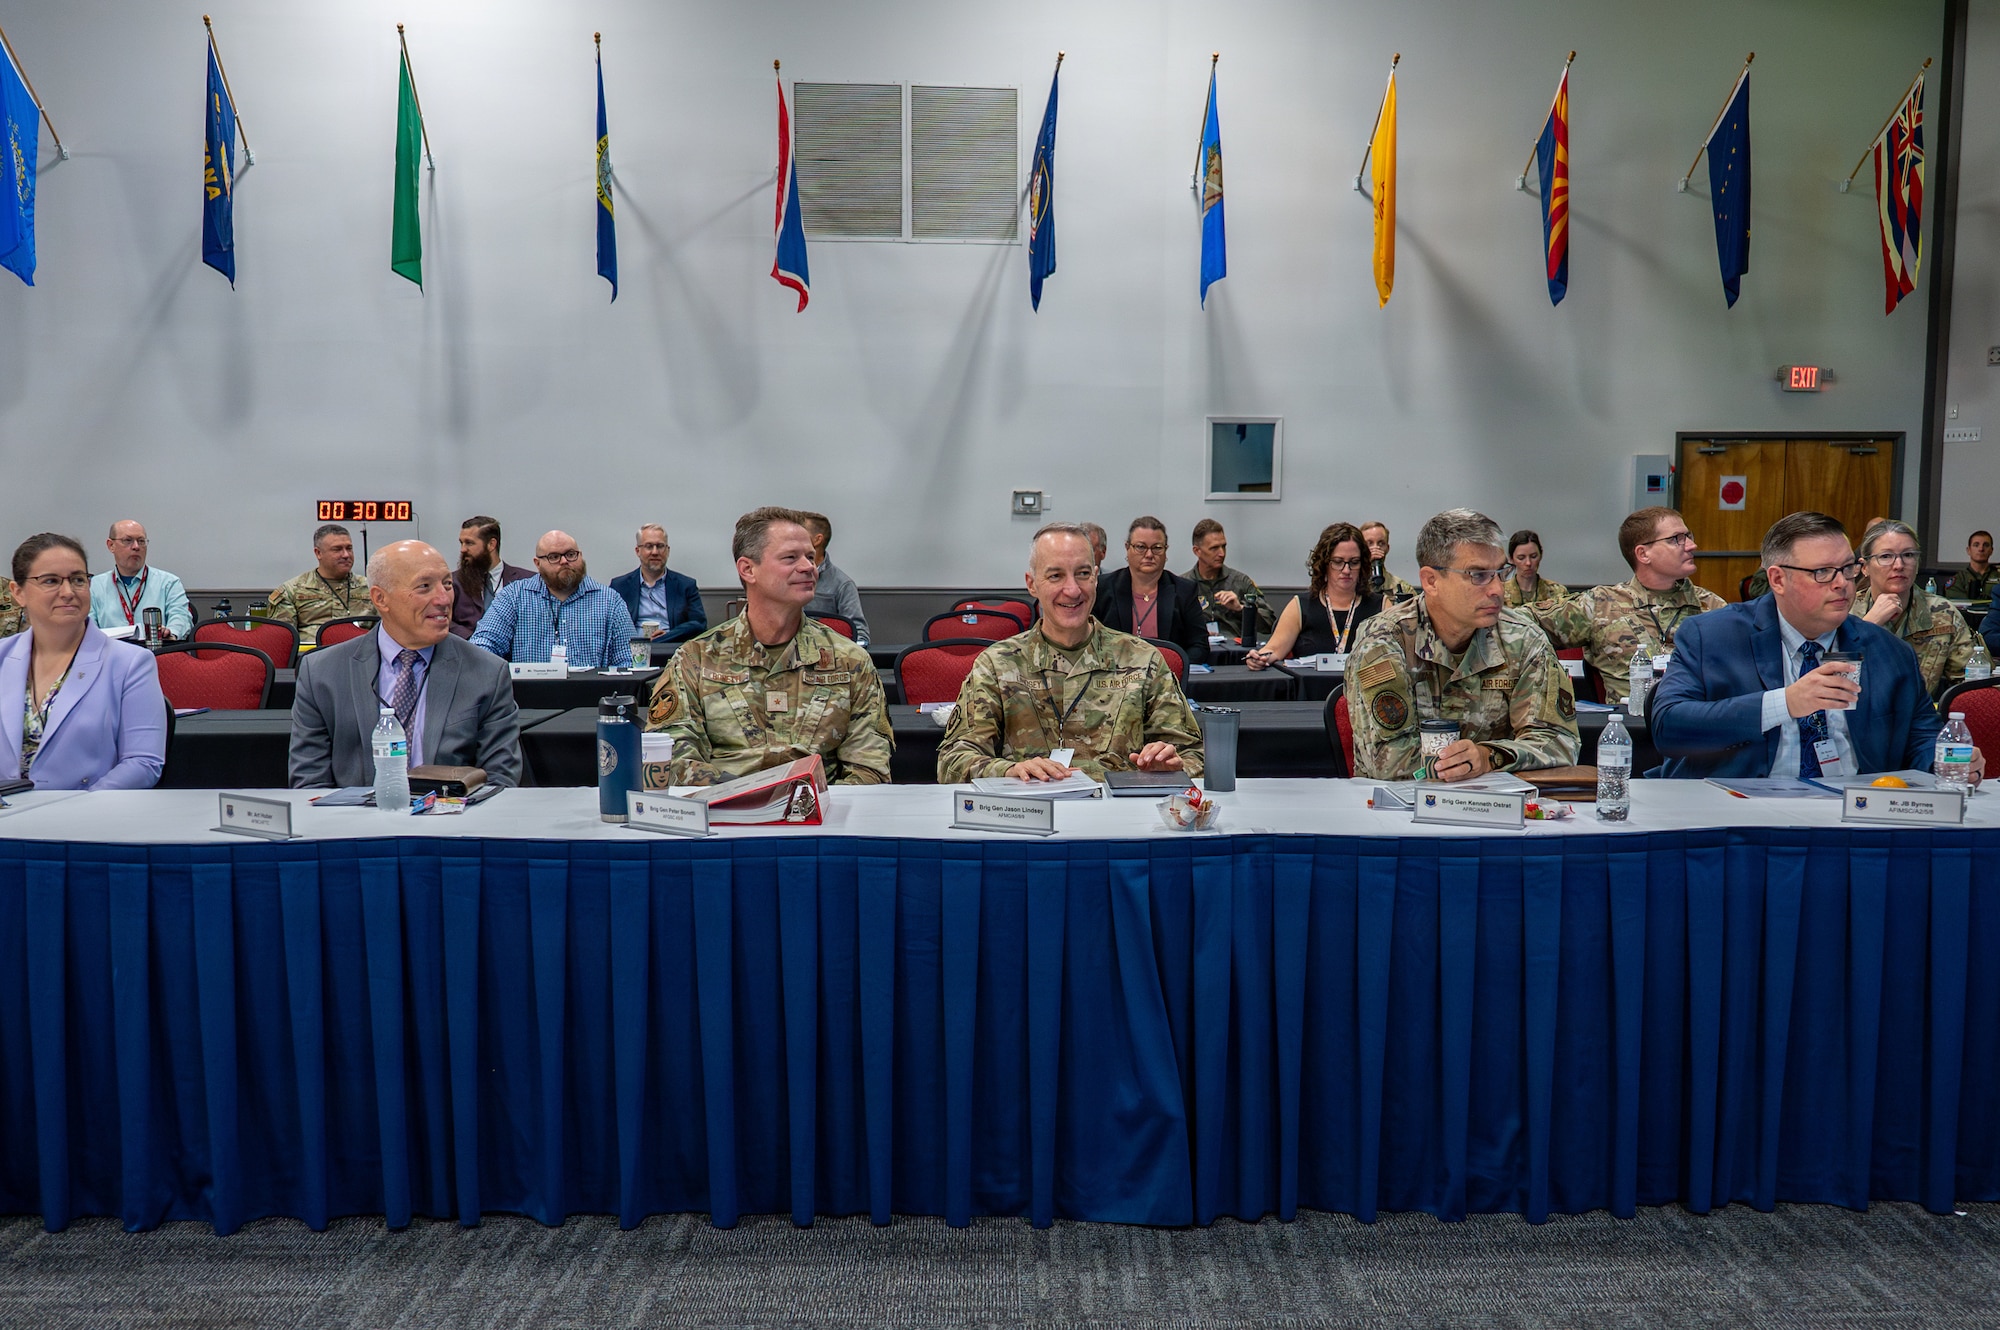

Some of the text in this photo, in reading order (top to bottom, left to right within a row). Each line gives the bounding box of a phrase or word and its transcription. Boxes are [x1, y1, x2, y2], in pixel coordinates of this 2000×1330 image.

[1791, 367, 1818, 388] EXIT
[319, 502, 409, 520] 00 30 00
[1096, 673, 1142, 688] U.S. AIR FORCE
[1482, 679, 1493, 689] AIR
[1441, 798, 1454, 806] Brig
[1911, 801, 1934, 809] Byrnes
[650, 805, 659, 813] Brig
[979, 804, 991, 812] Brig
[1022, 807, 1044, 815] Lindsey
